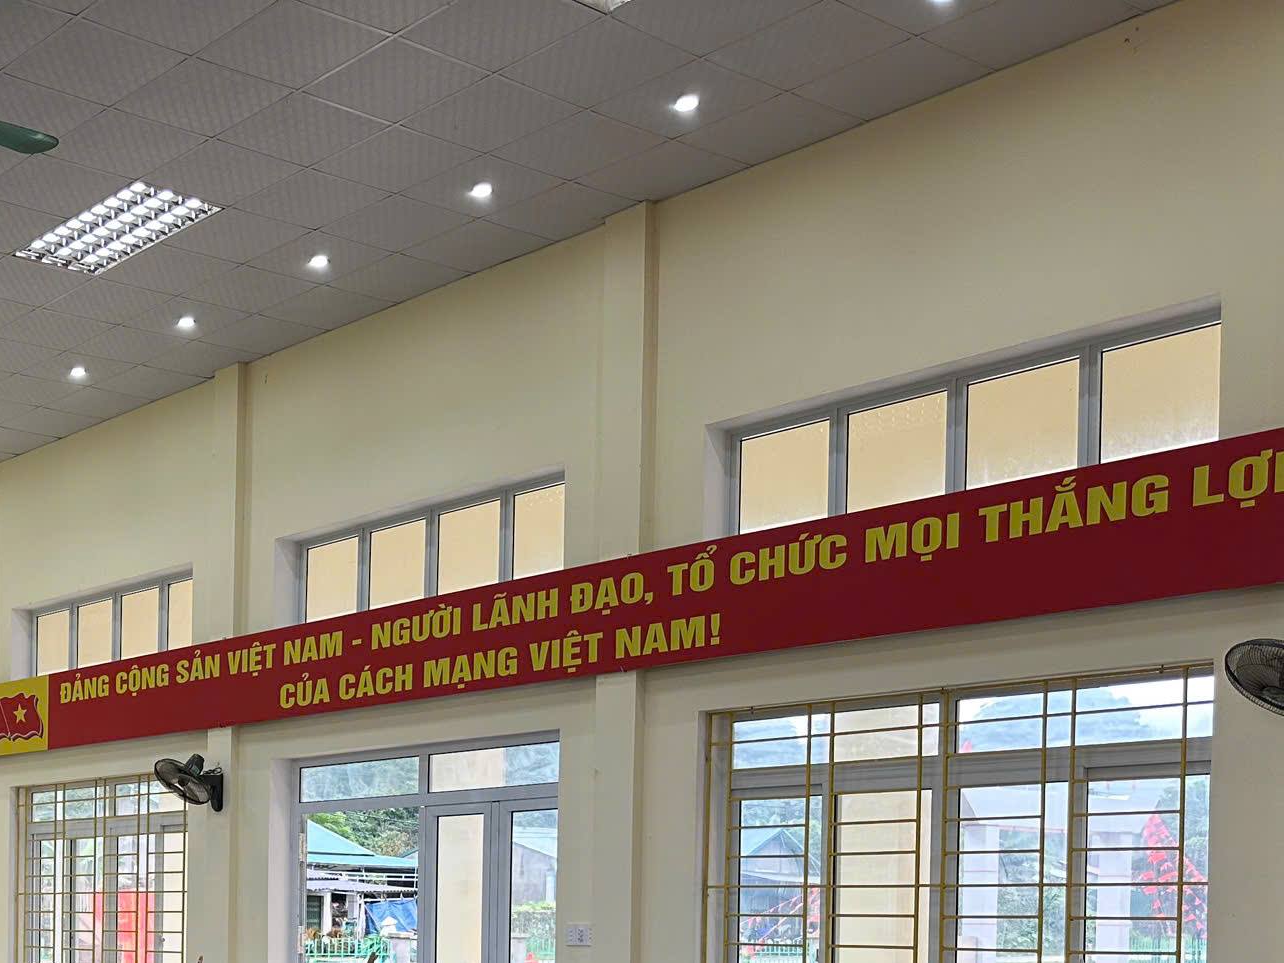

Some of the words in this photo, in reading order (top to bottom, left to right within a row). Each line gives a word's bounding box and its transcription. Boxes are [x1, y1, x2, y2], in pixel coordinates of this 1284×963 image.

[59, 674, 109, 704] ĐẢNG
[115, 664, 170, 697] CỘNG
[176, 650, 221, 683] SẢN
[227, 642, 276, 677] VIỆT
[283, 631, 343, 665] NAM
[352, 638, 362, 646] -
[371, 602, 462, 650] NGƯỜI
[472, 587, 559, 632] LÃNH
[570, 572, 654, 616] ĐẠO,
[667, 544, 718, 597] TỔ
[729, 532, 848, 586] CHỨC
[864, 511, 960, 563] MỌI
[978, 475, 1170, 543] THẮNG
[1192, 448, 1284, 508] LỢI
[279, 672, 330, 709] CỦA
[339, 663, 413, 701] CÁCH
[423, 646, 518, 690] MẠNG
[529, 630, 604, 673] VIỆT
[615, 613, 722, 660] NAM!
